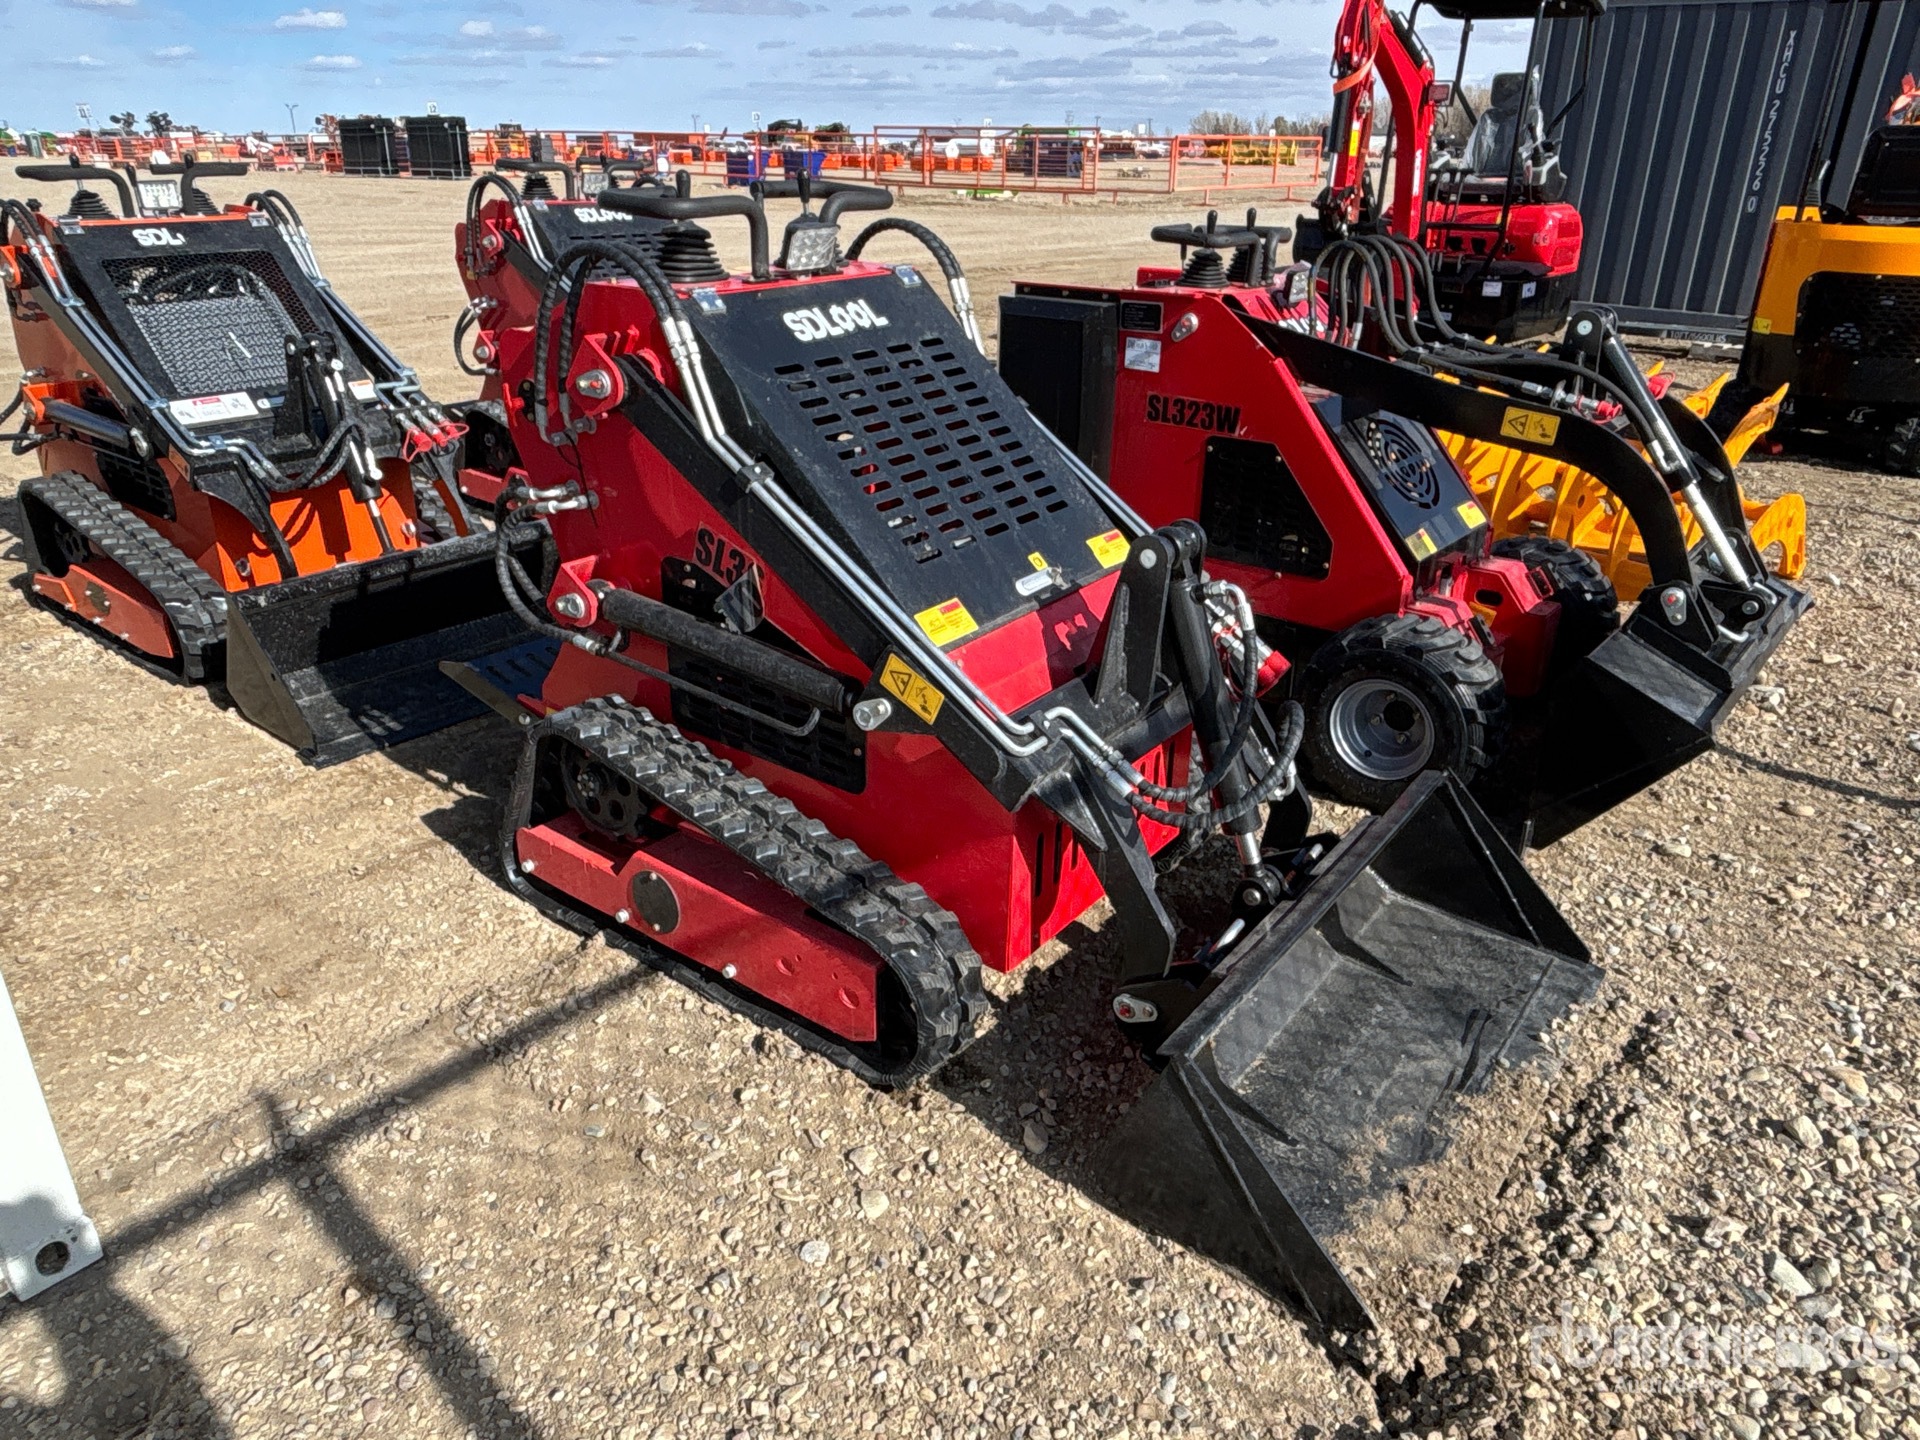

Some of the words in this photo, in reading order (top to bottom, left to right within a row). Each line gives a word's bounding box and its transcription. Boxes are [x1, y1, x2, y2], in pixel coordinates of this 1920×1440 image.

[1775, 29, 1797, 94] XHCU
[1752, 99, 1781, 191] 275226
[783, 298, 889, 342] SDLOOL
[1146, 393, 1241, 434] SL323W
